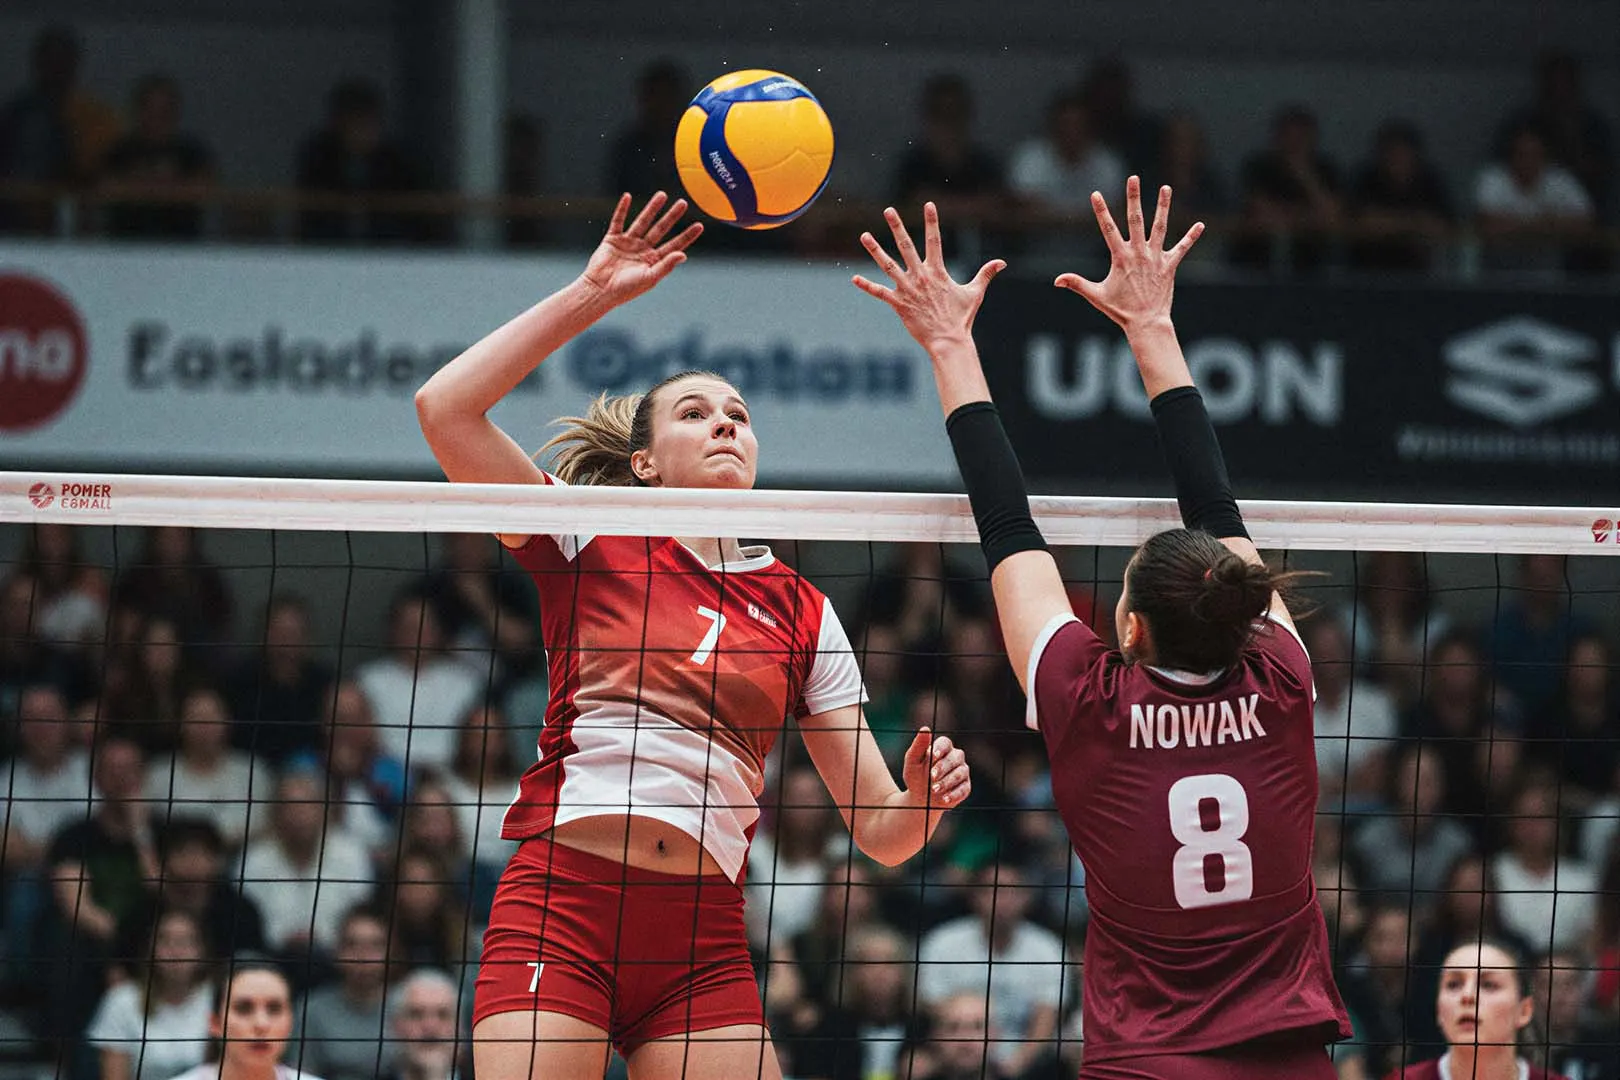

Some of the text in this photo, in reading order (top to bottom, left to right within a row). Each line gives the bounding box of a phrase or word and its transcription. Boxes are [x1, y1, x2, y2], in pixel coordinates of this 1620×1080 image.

[61, 483, 111, 498] POMER
[690, 605, 727, 666] 7
[1129, 694, 1267, 749] NOWAK
[1168, 773, 1253, 909] 8
[527, 962, 545, 992] 7
